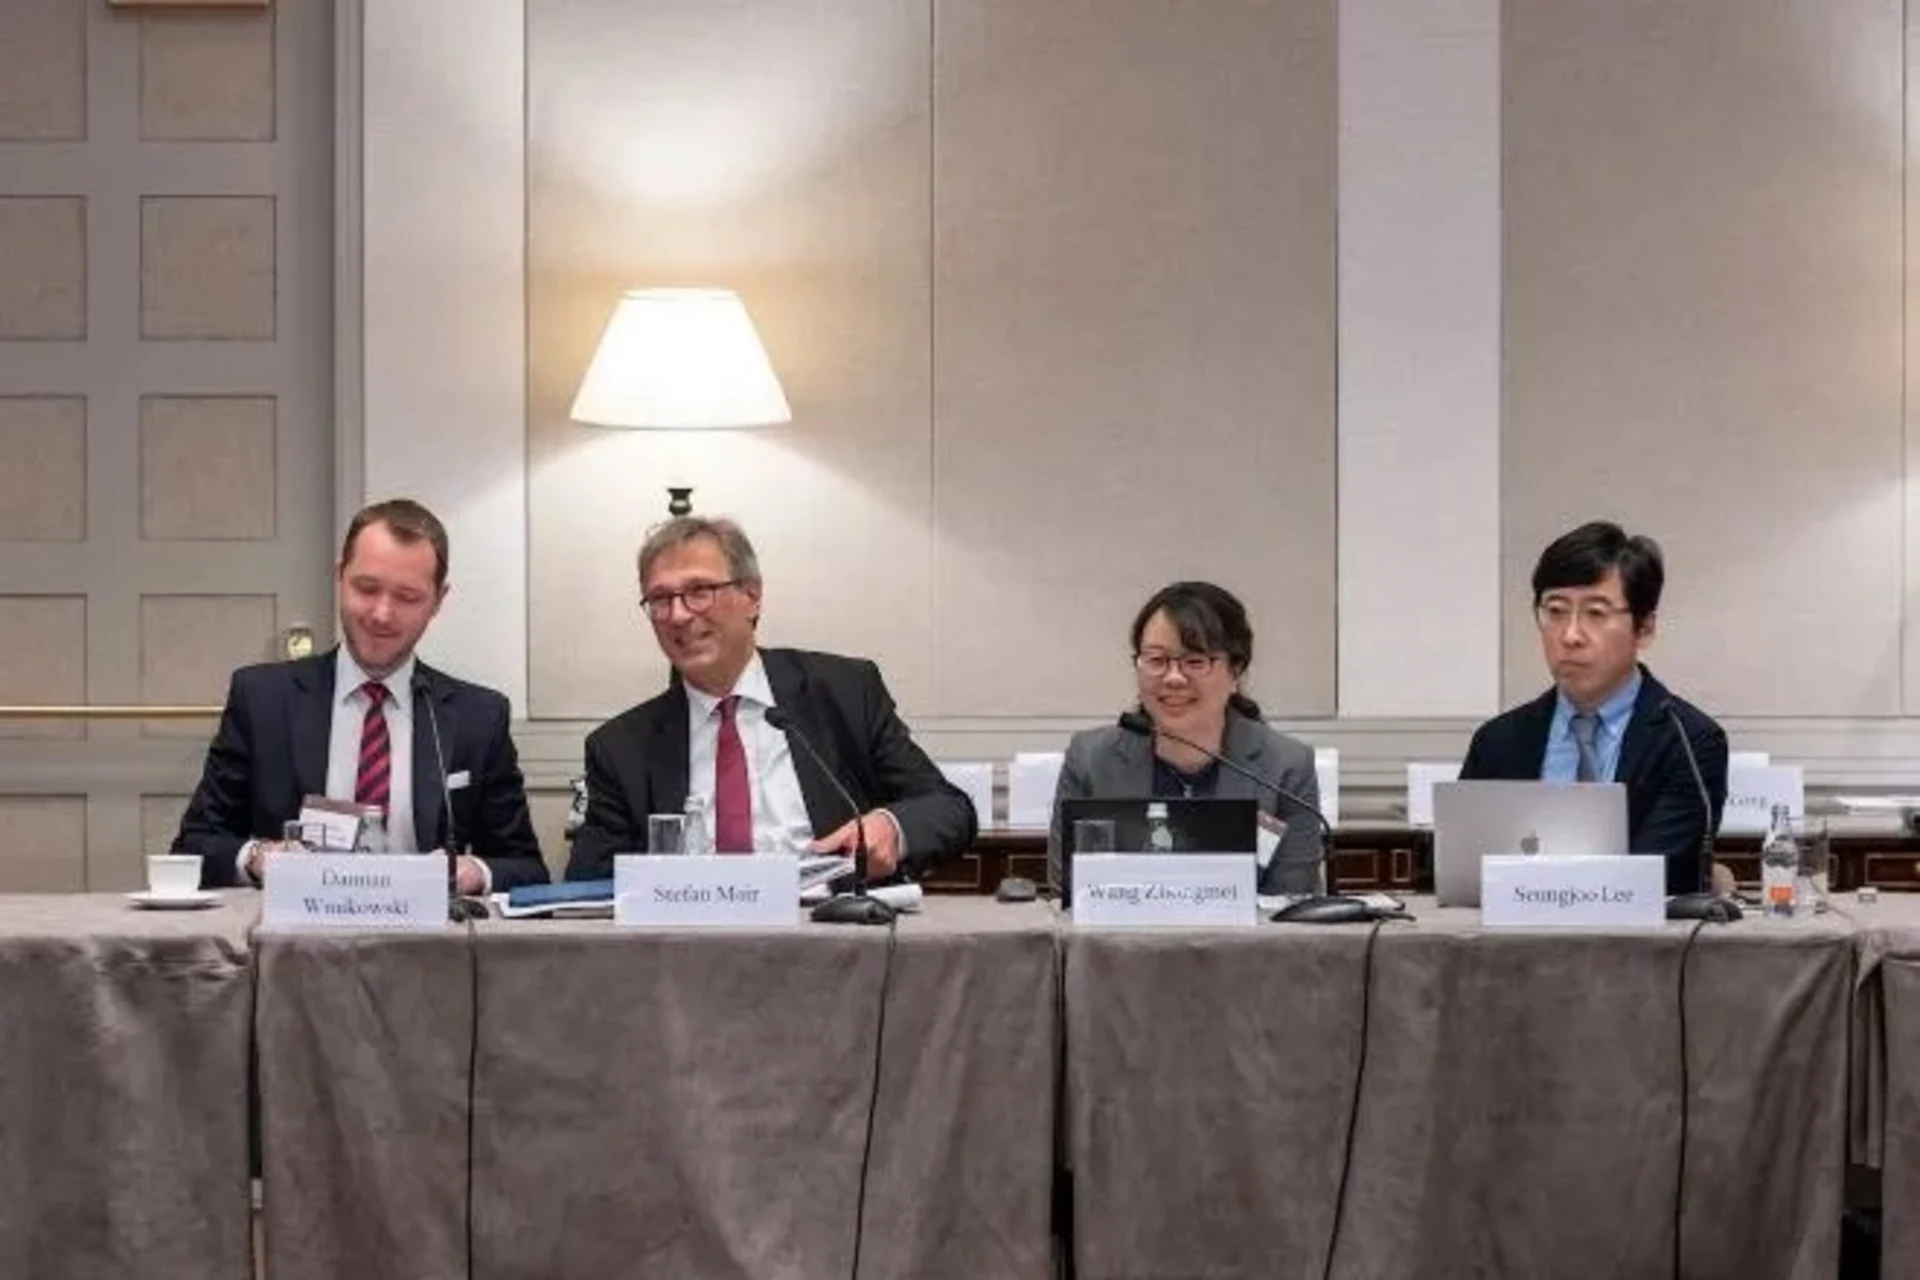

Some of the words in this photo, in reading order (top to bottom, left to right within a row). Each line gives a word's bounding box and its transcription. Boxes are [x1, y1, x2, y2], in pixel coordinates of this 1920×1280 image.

[321, 869, 391, 886] Damian
[653, 884, 711, 903] Stefan
[1087, 884, 1141, 906] Wang
[1513, 885, 1599, 908] Seungjoo
[1602, 885, 1636, 903] Lee
